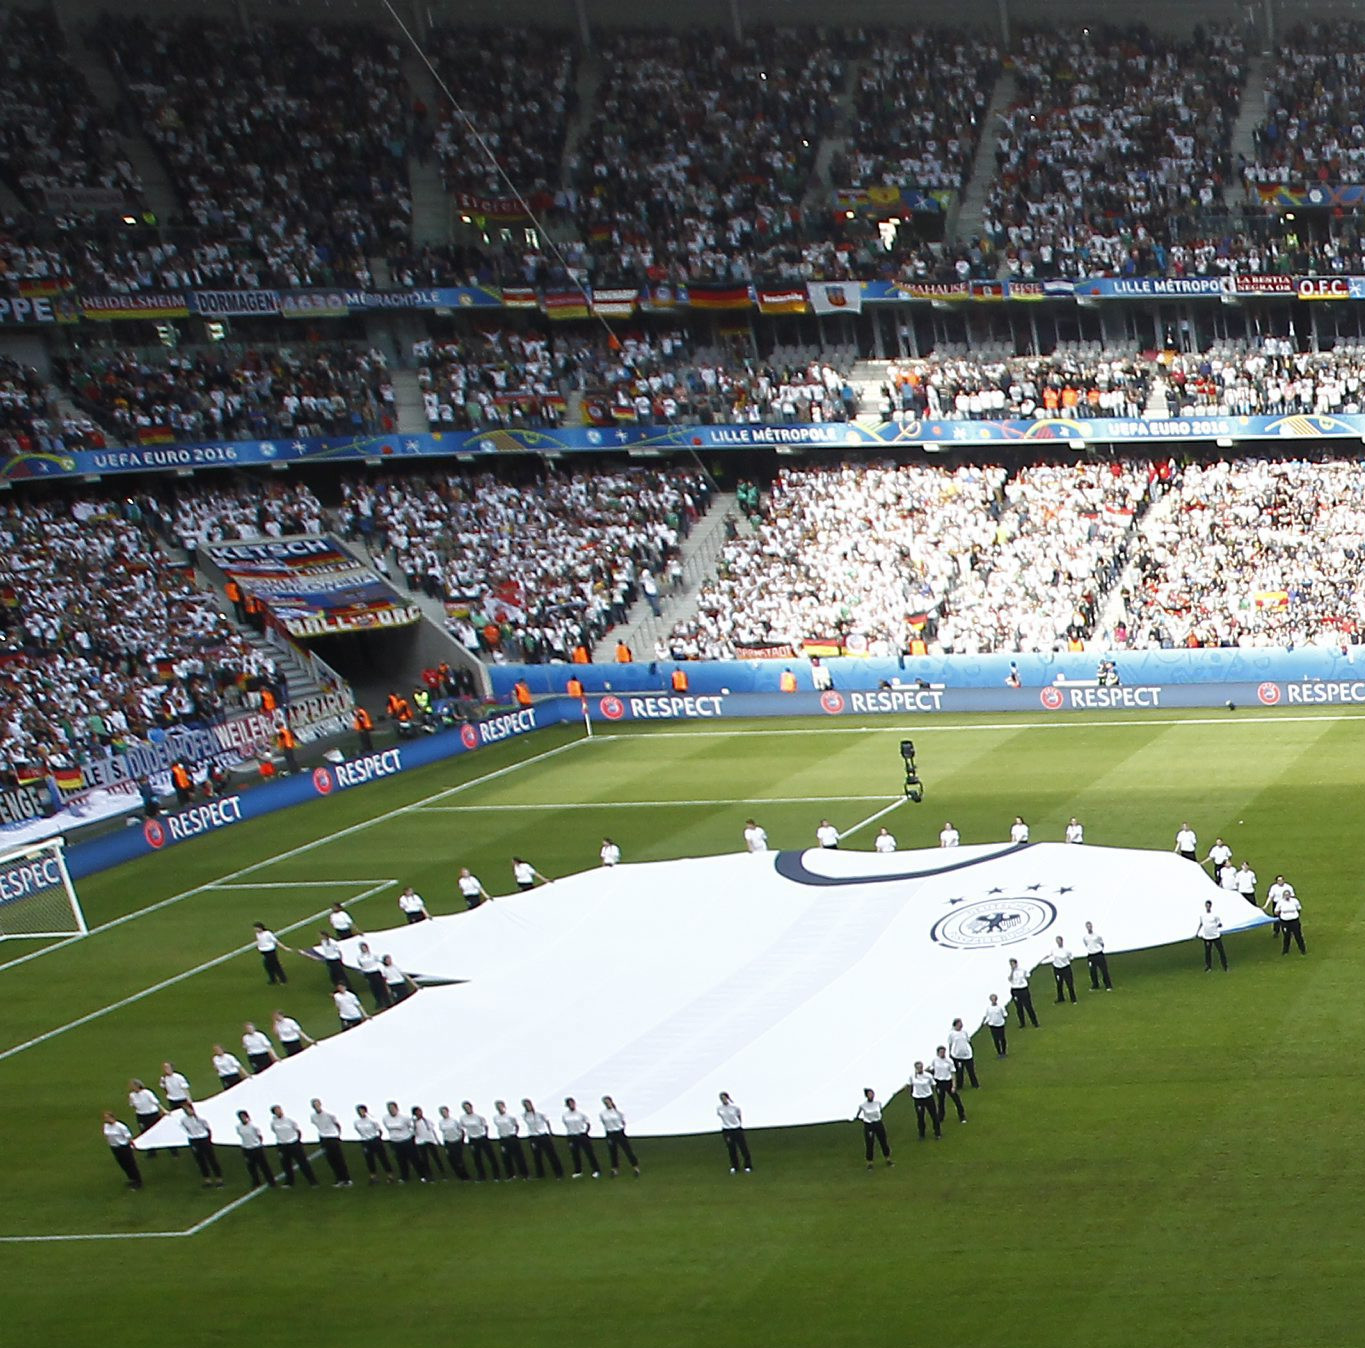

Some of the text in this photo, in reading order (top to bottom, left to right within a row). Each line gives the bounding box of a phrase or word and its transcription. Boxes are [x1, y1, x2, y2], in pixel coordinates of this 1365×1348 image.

[1114, 278, 1222, 293] LILLE MÉTROPO
[1299, 279, 1347, 295] O.F.C.
[200, 293, 275, 312] DORMAGEN
[711, 426, 837, 444] LILLE MÉTROPOLE
[1108, 421, 1230, 437] UEFA EURO 2016
[94, 448, 237, 469] UEFA EURO 2016
[212, 540, 327, 560] KETSCH
[631, 695, 722, 718] RESPECT
[851, 689, 943, 712] RESPECT
[1070, 686, 1161, 708] RESPECT
[479, 708, 537, 743] RESPECT
[336, 748, 401, 788] RESPECT
[168, 795, 243, 839] RESPECT
[0, 857, 60, 900] ESPEC
